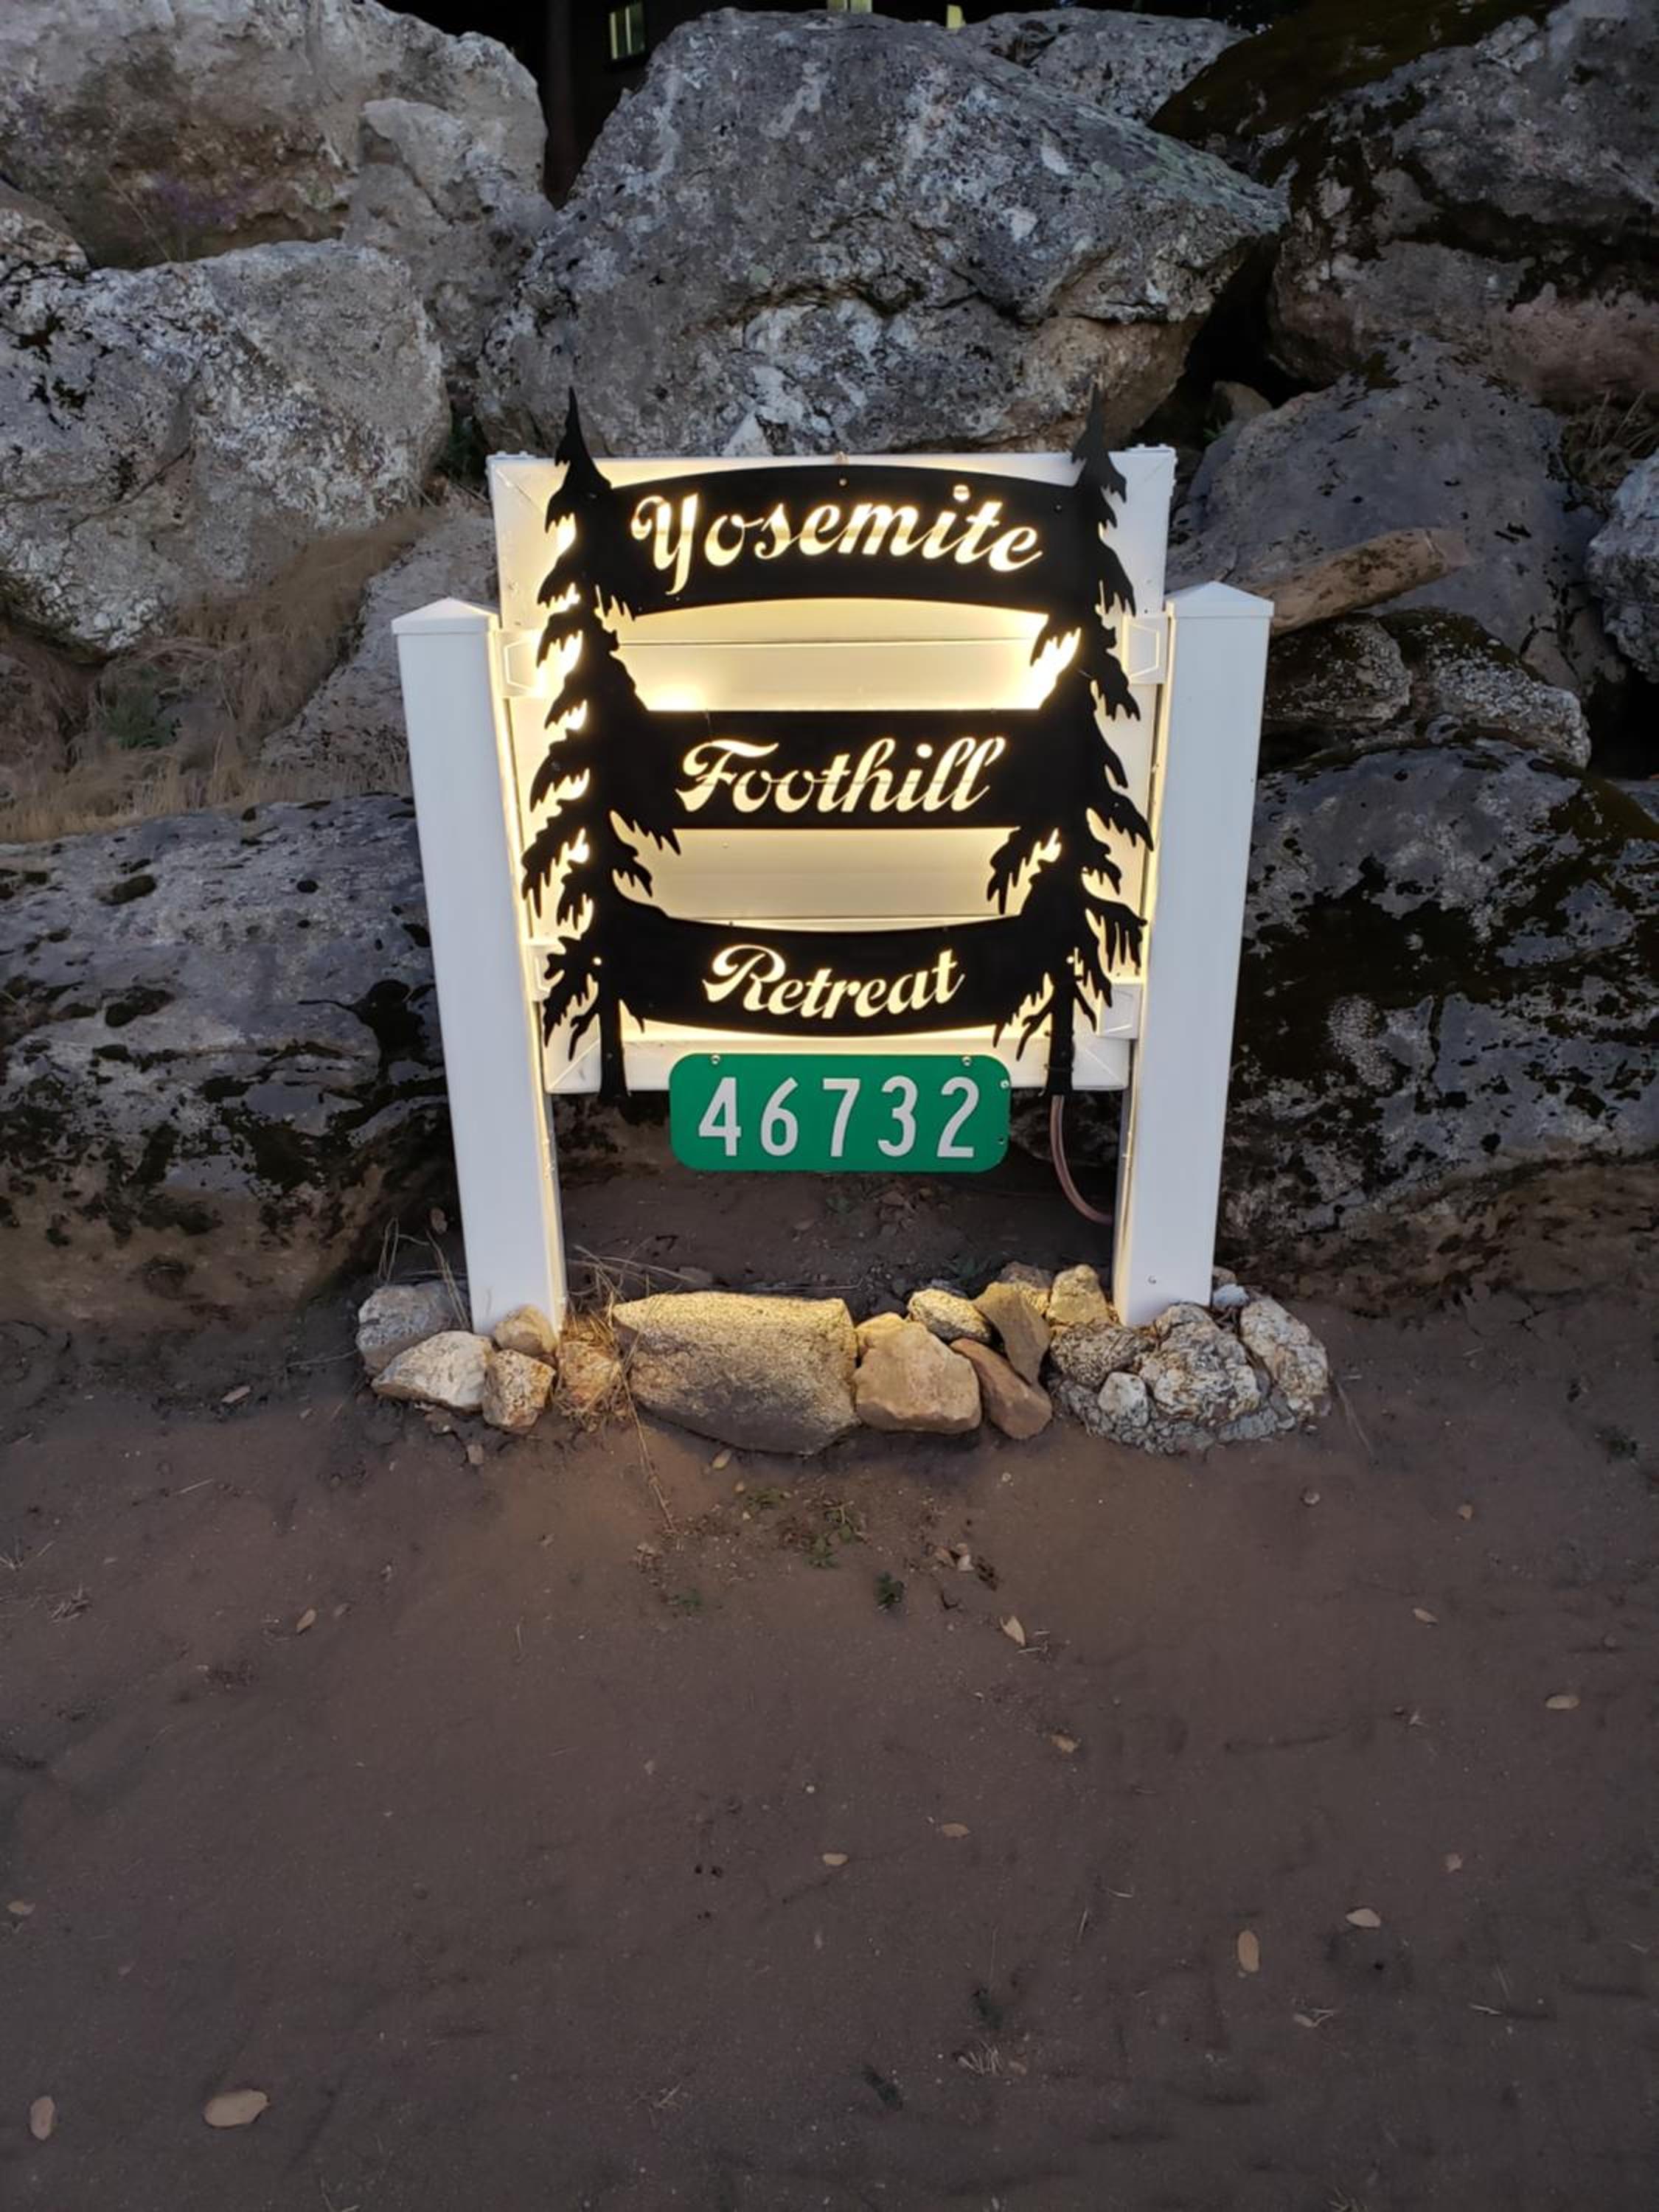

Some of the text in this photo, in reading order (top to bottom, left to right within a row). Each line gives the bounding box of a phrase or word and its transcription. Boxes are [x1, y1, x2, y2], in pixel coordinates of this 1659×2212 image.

[630, 484, 1043, 595] Yosemite
[675, 737, 1006, 813] Foothill
[702, 944, 965, 1019] Retreat
[698, 1076, 980, 1158] 46732
